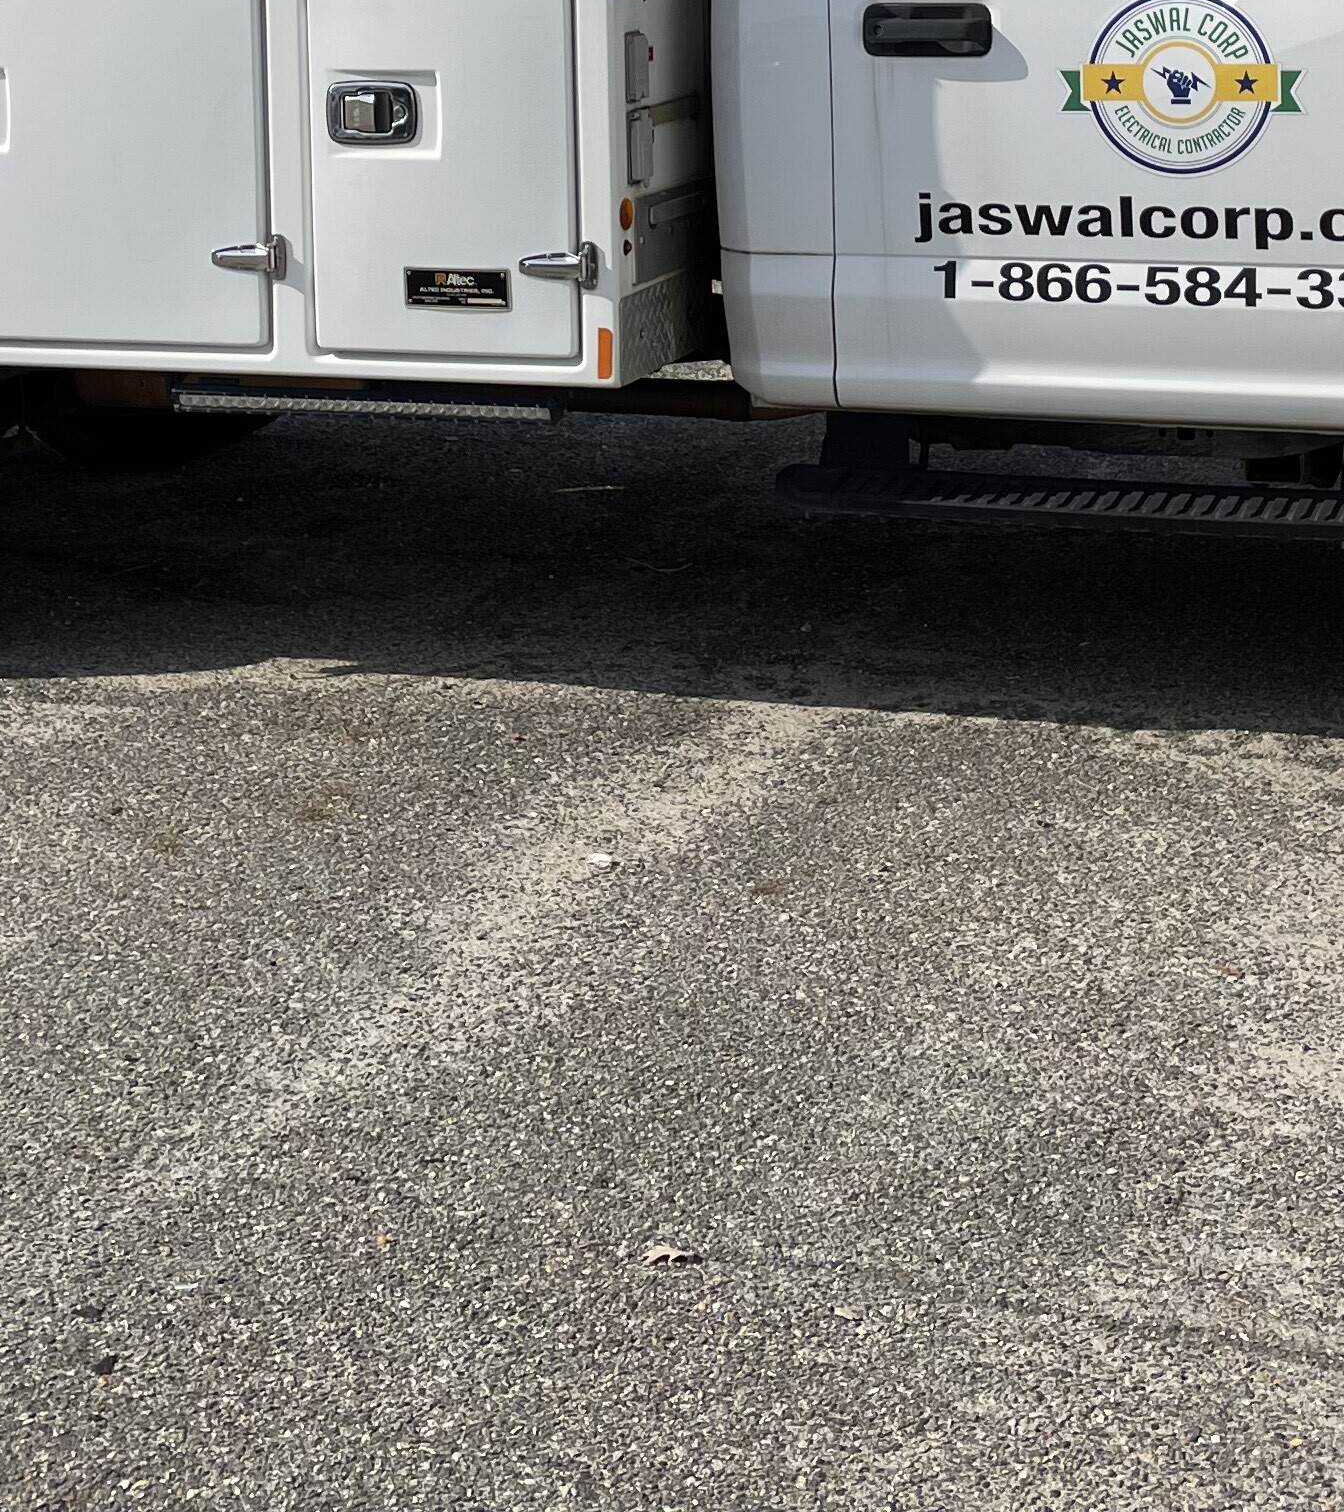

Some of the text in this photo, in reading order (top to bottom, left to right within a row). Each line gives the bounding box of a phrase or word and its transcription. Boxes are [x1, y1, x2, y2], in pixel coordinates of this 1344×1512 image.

[1115, 7, 1249, 60] JASWAL CORP
[1114, 105, 1246, 155] ELECTRICAL CONTRACTOR
[447, 273, 475, 285] Altec
